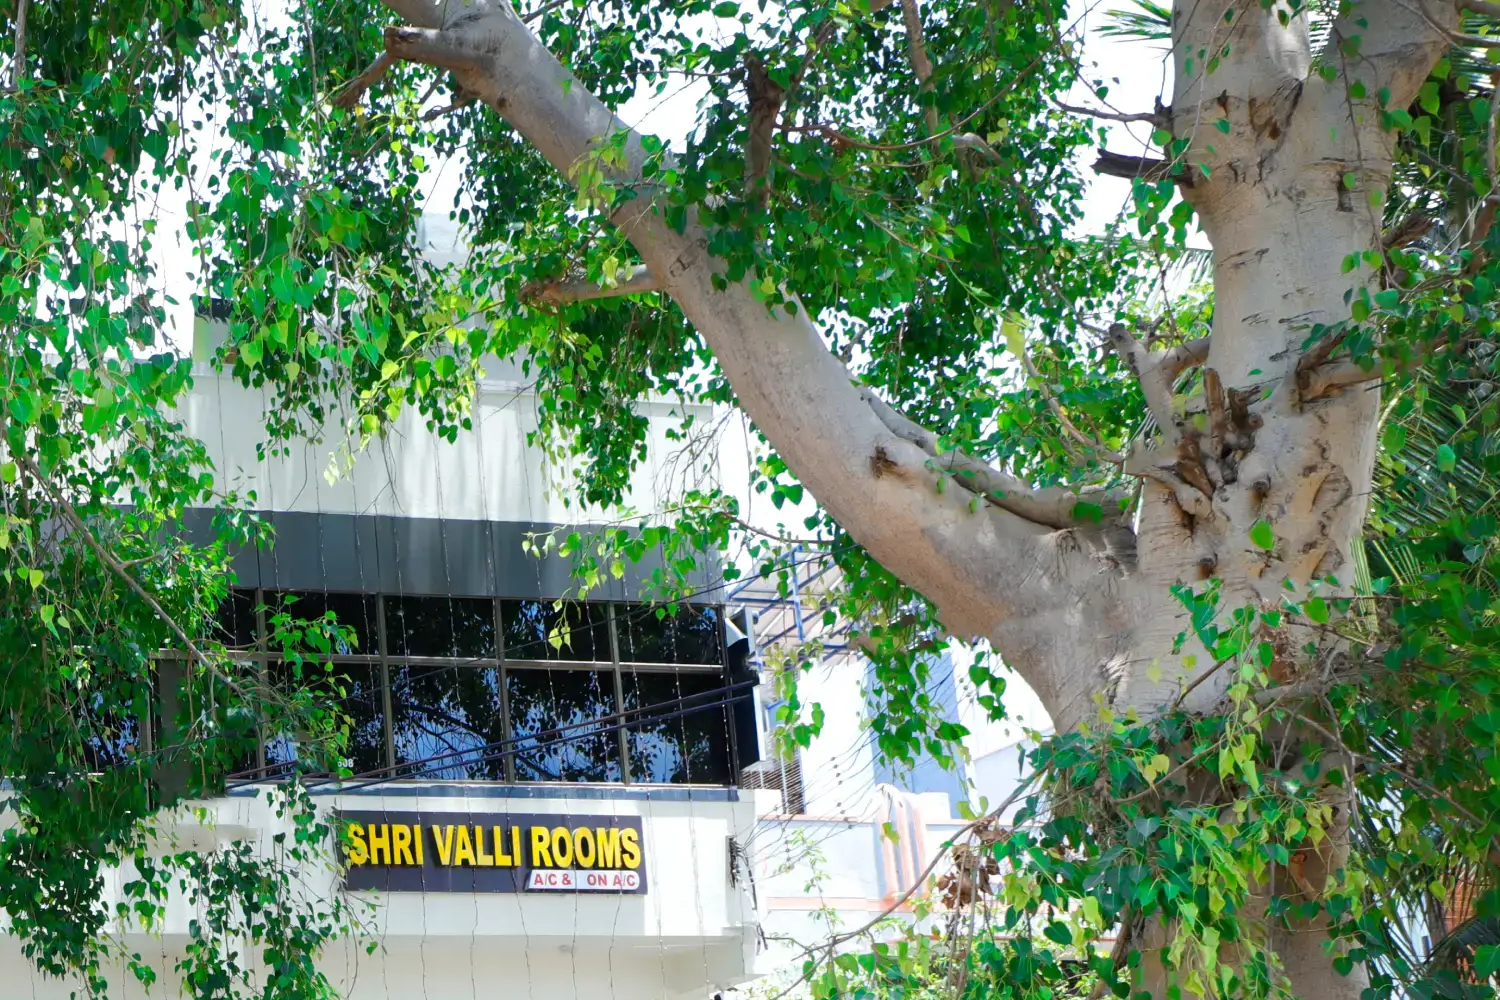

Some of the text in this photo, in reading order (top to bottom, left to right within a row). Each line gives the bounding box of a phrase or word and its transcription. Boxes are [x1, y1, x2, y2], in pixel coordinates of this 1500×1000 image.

[348, 823, 641, 869] SHRI VALLI ROOMS
[534, 873, 557, 886] A/C
[562, 873, 572, 886] &
[613, 874, 635, 887] A/C
